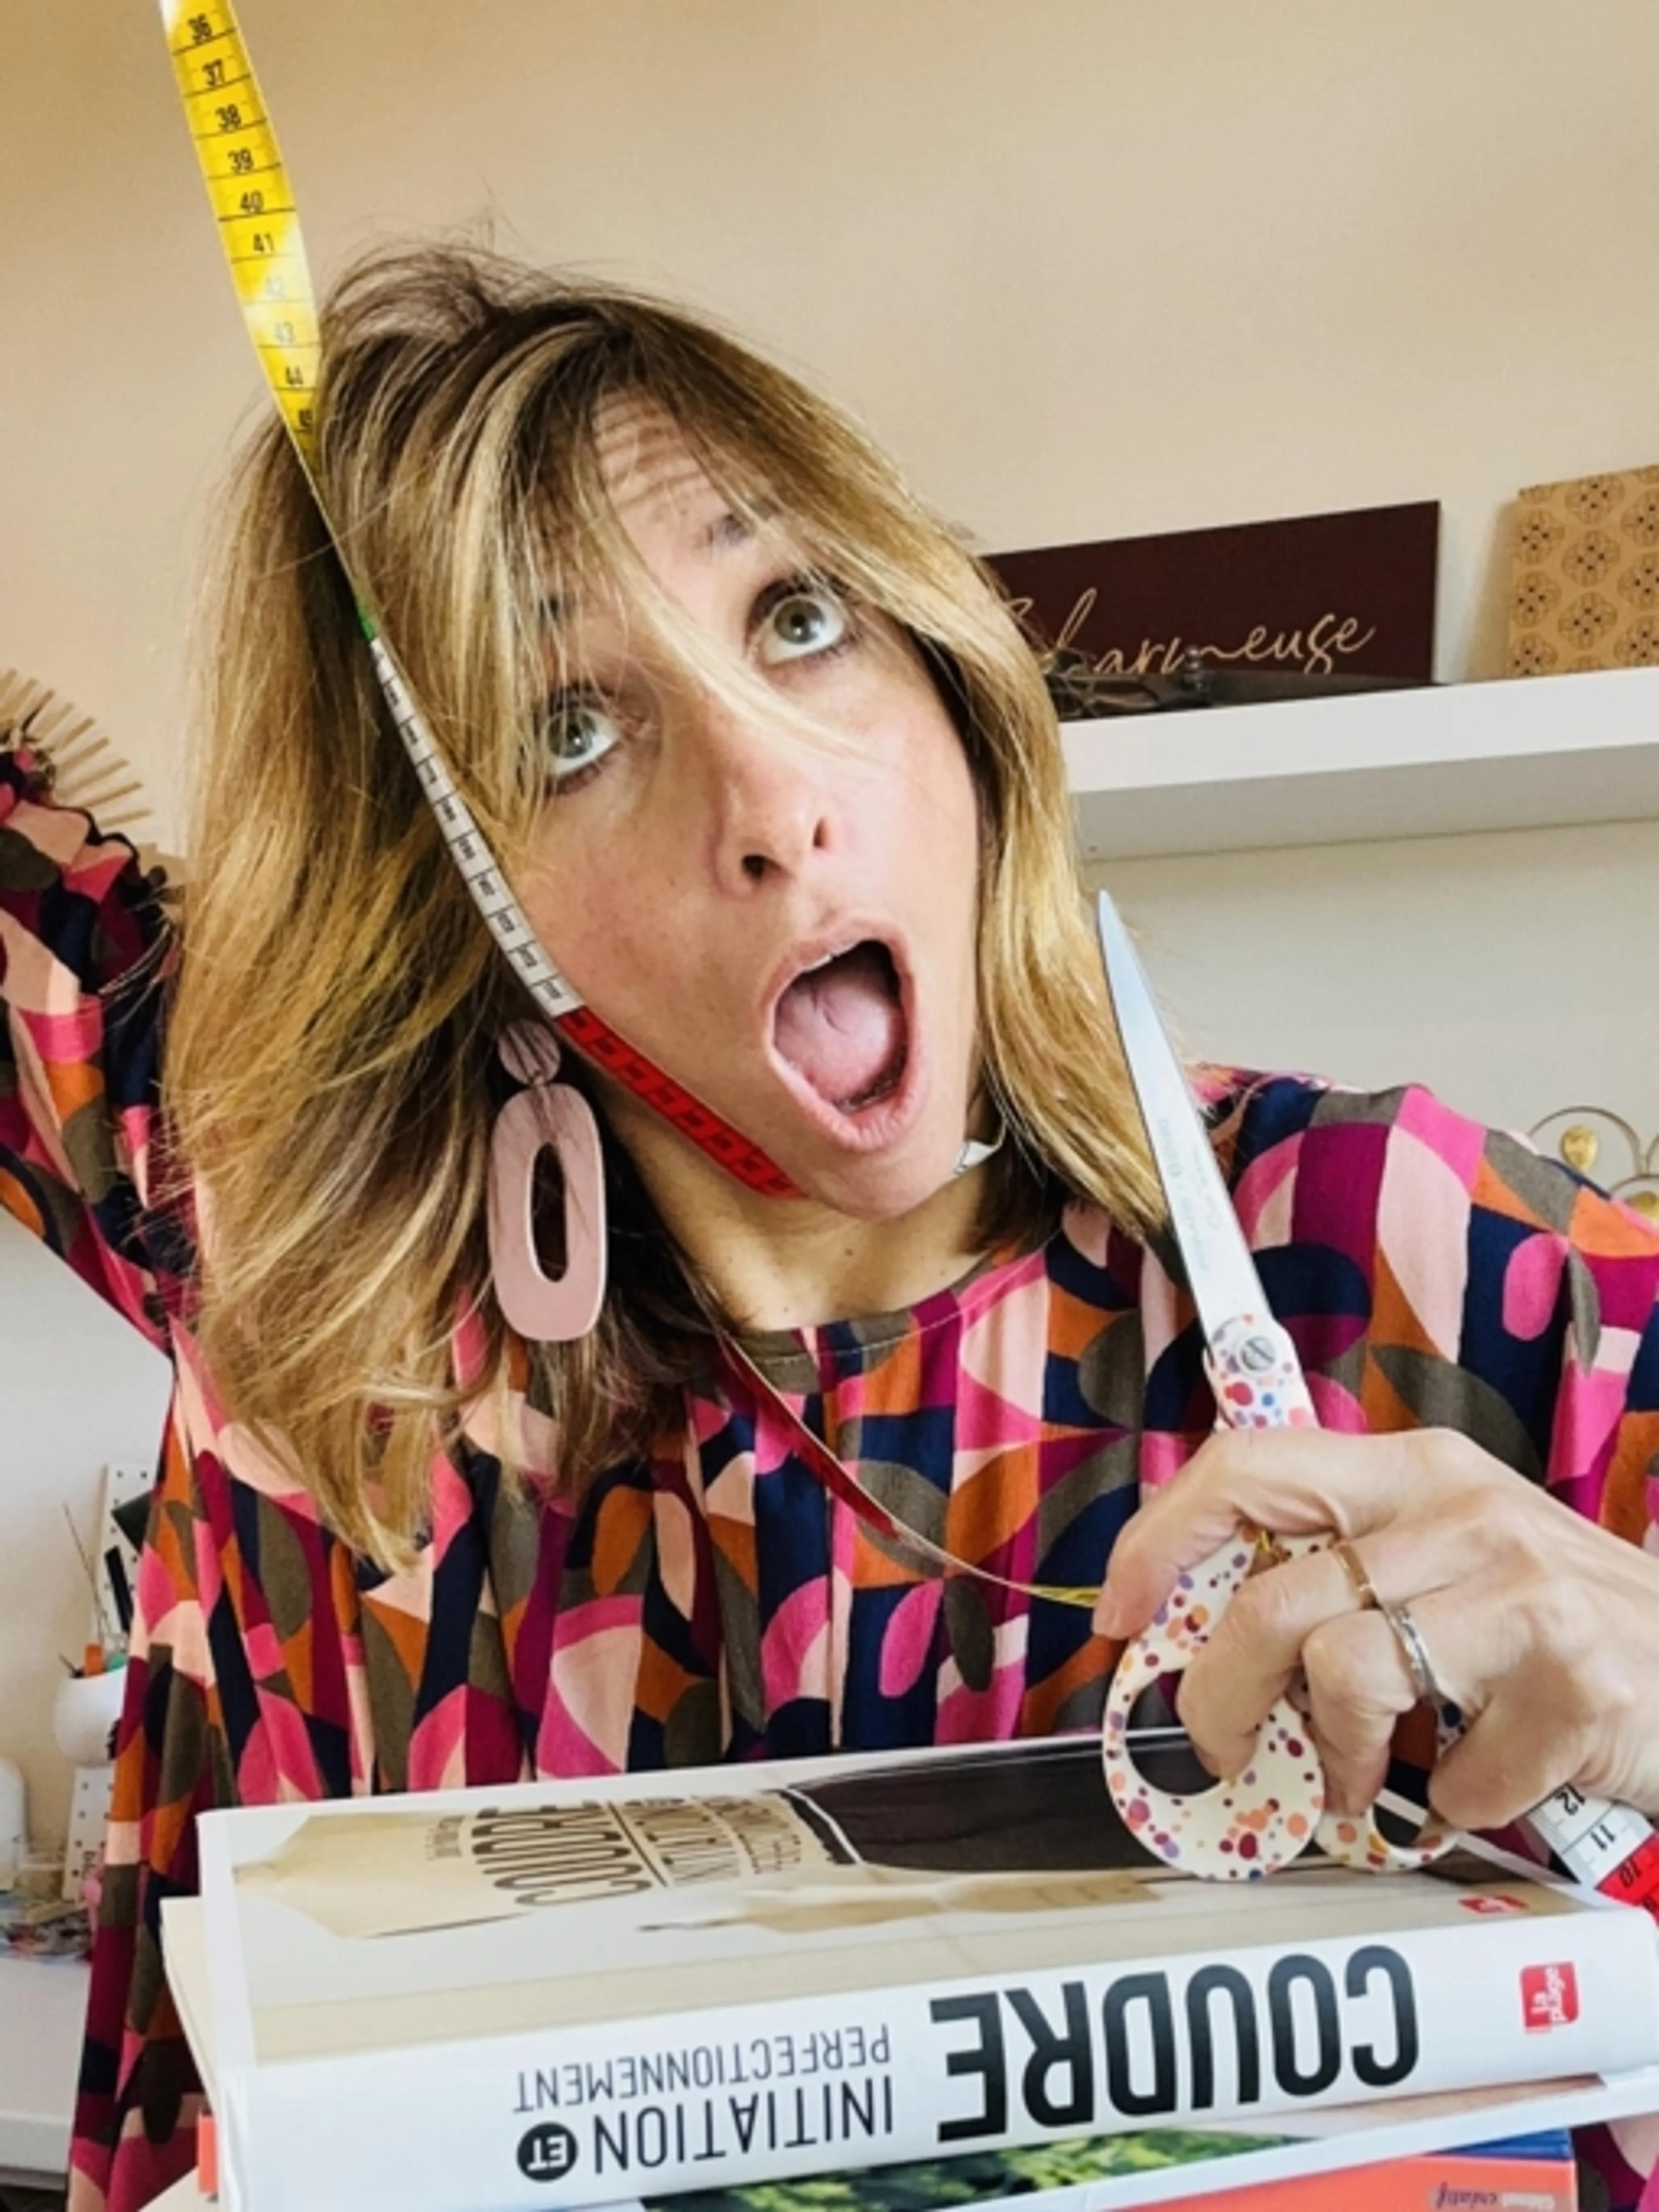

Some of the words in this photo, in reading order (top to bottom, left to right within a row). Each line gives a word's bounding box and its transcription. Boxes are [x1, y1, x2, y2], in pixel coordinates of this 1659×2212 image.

[202, 59, 225, 86] 37
[215, 104, 242, 131] 38
[228, 148, 254, 174] 39
[241, 190, 264, 213] 40
[253, 233, 275, 252] 41
[275, 322, 296, 343] 43
[286, 366, 303, 385] 44
[1555, 1782, 1586, 1816] 12
[1591, 1824, 1616, 1851] 11
[471, 1799, 652, 1906] COUDRE
[1620, 1858, 1641, 1888] 10
[929, 1944, 1420, 2143] COUDRE
[513, 2023, 890, 2114] PERFECTIONNEMENT
[593, 2074, 893, 2174] INITIATION
